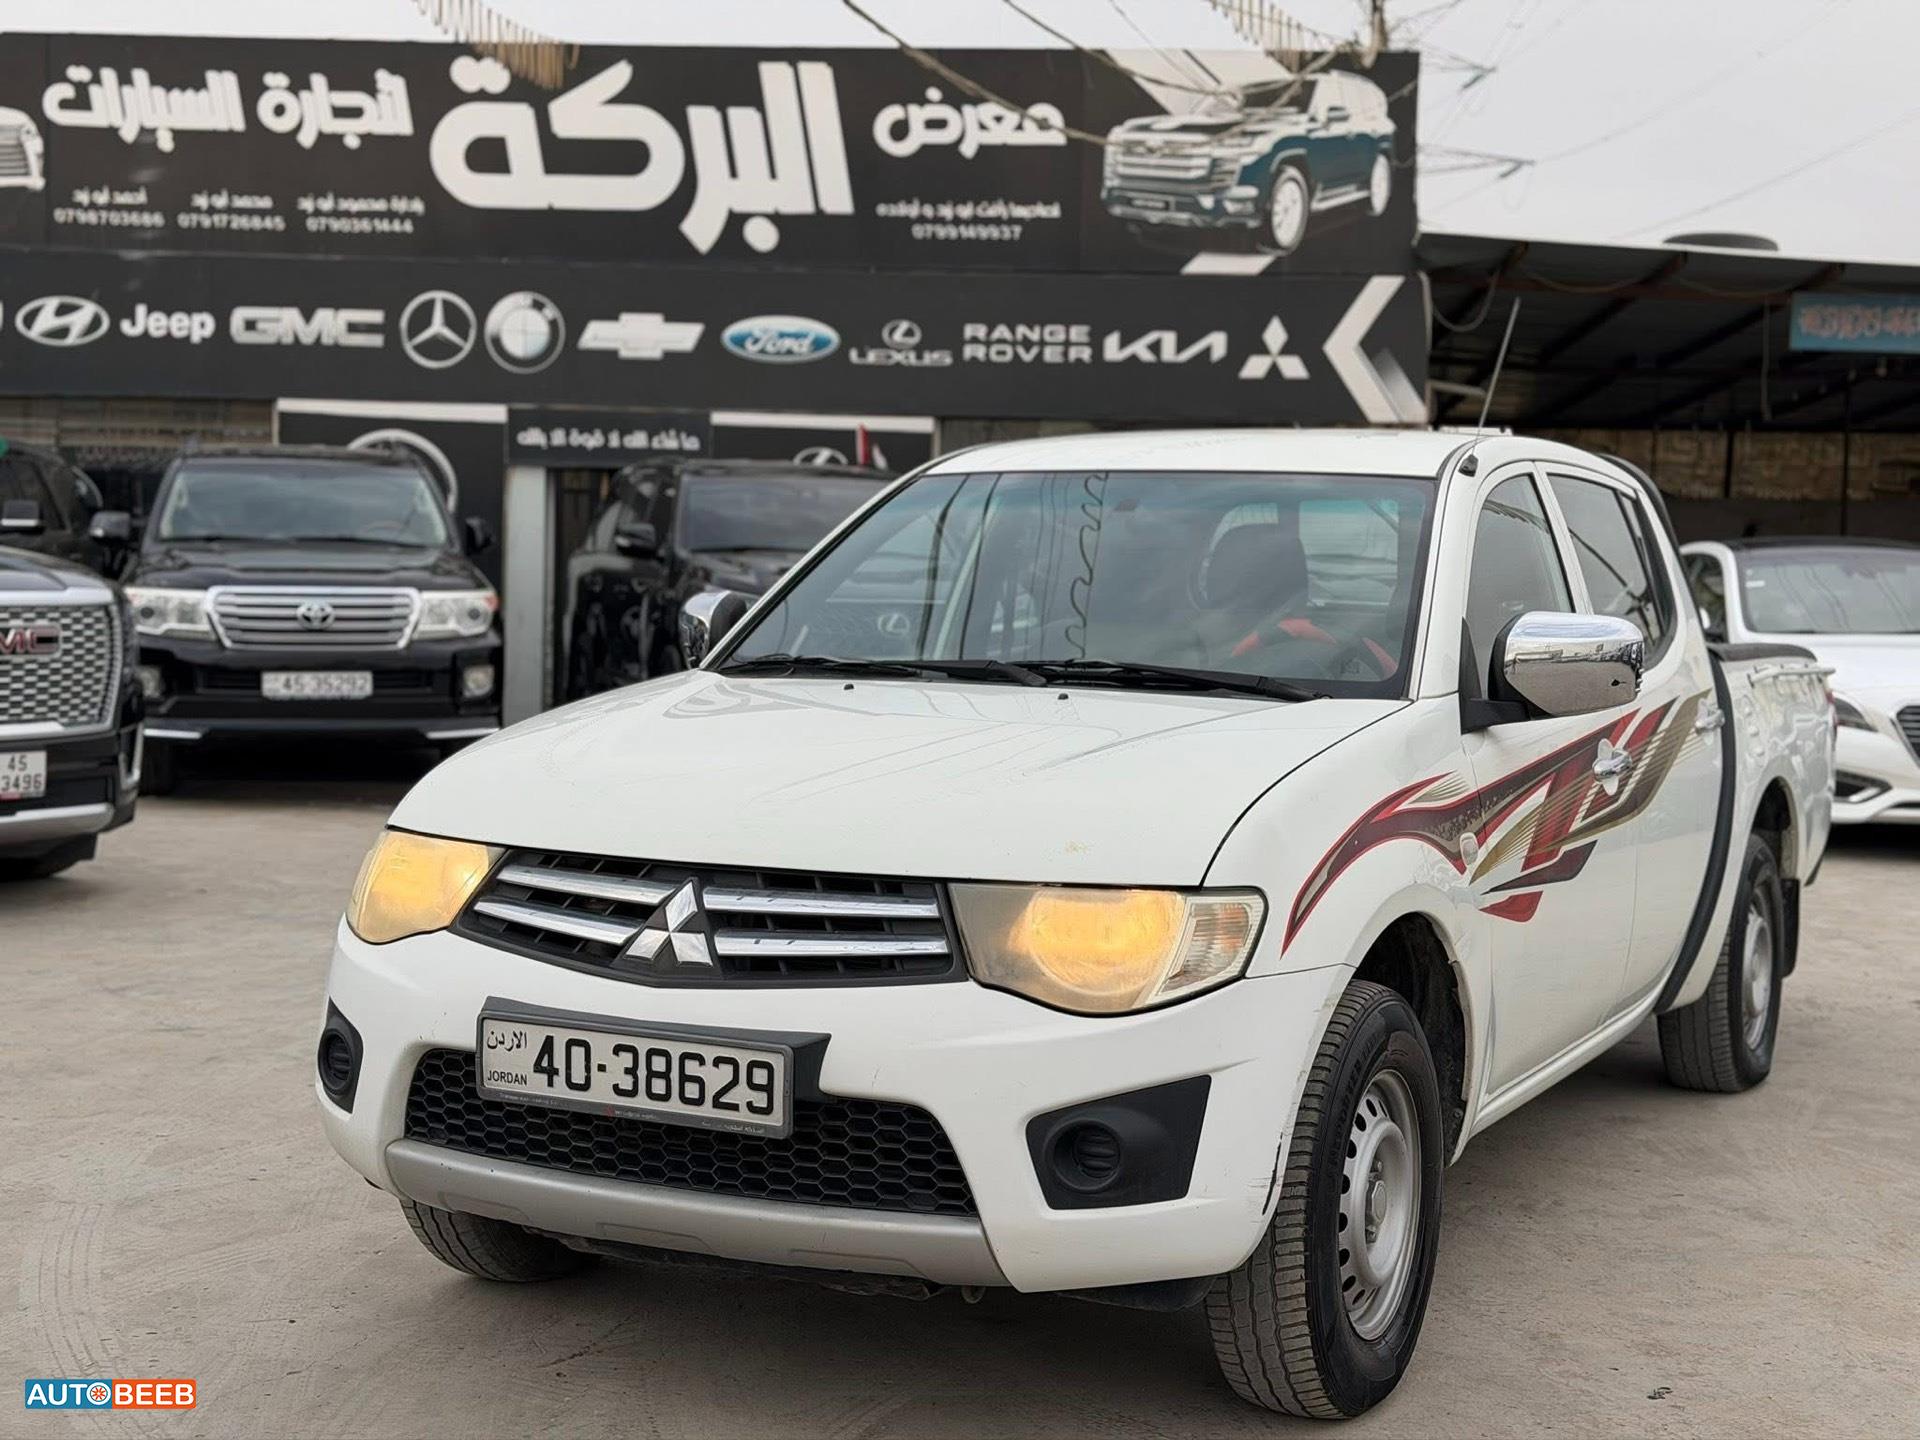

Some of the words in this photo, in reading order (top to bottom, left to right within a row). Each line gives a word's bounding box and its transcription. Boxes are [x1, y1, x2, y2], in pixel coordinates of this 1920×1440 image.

[43, 65, 246, 153] السيارات
[256, 68, 414, 150] لتجارة
[873, 86, 1068, 159] معرض
[430, 55, 855, 254] البركة
[120, 303, 216, 343] Jeep
[230, 306, 385, 347] GMC
[744, 325, 814, 355] Ford
[963, 323, 1091, 343] RANGE
[848, 346, 954, 366] LEXUS
[962, 343, 1093, 364] ROVER
[1102, 330, 1228, 363] KIA
[8, 754, 28, 771] 45
[487, 1069, 528, 1087] JORDAN
[532, 1034, 775, 1116] 40-38629
